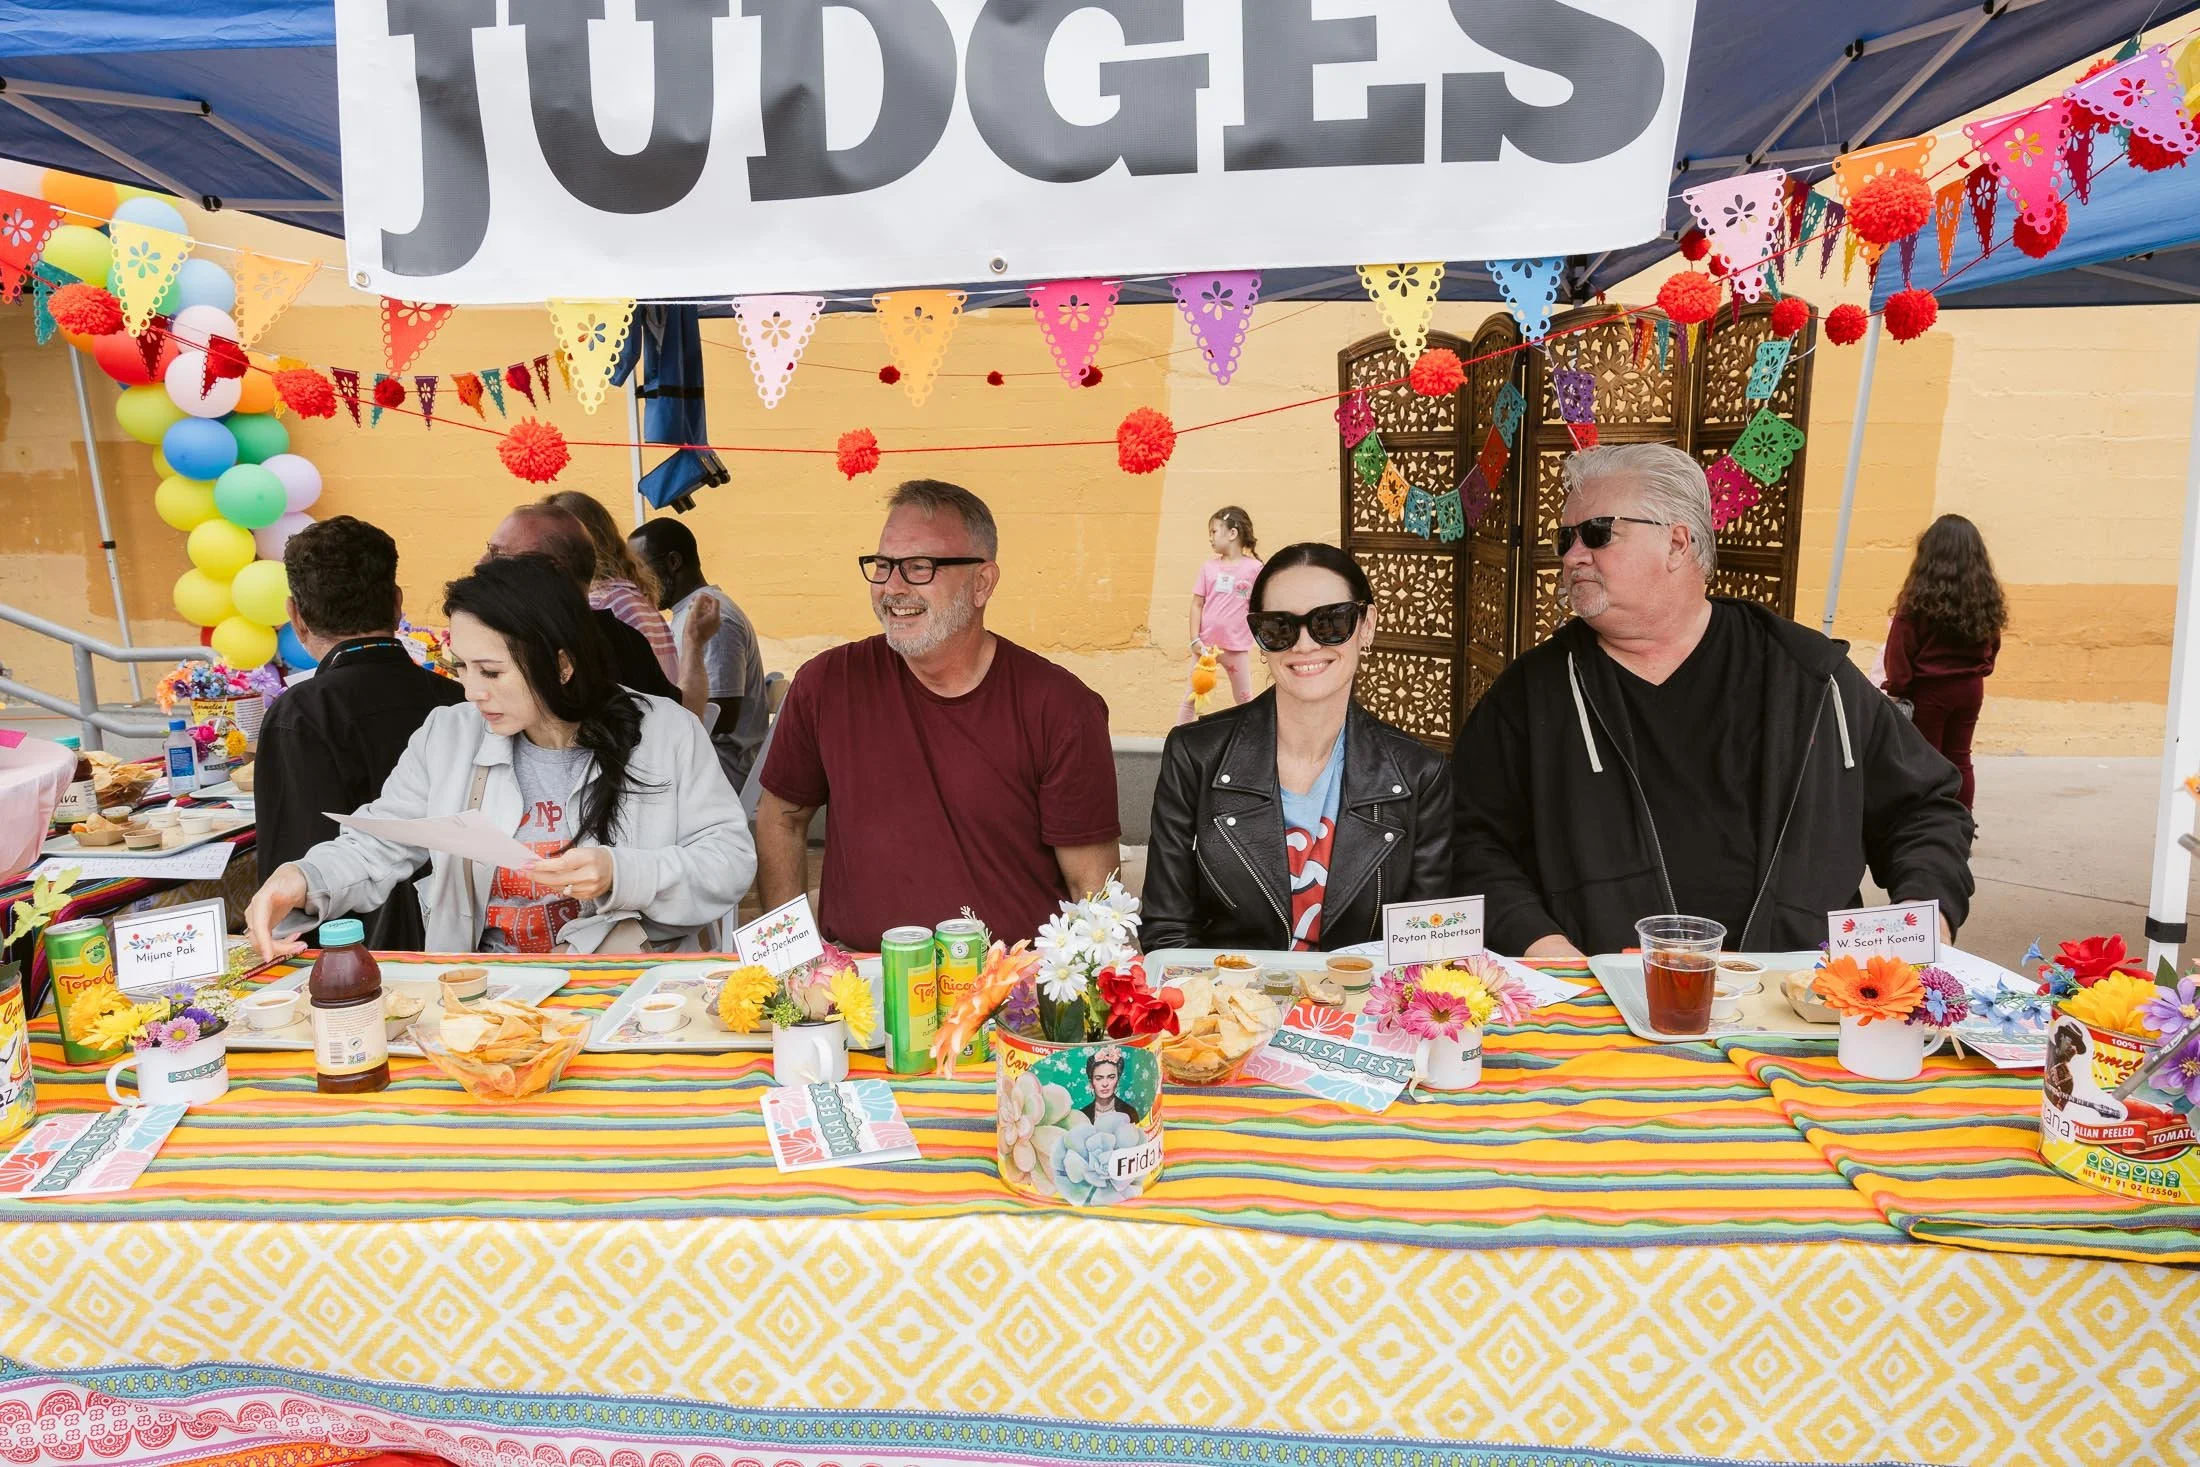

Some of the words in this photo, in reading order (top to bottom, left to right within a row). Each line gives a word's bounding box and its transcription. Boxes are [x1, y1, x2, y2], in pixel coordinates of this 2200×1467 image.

[381, 0, 1667, 276] JUDGES
[535, 800, 563, 832] NP
[752, 944, 771, 962] Chef
[772, 928, 810, 952] Deckman
[1392, 933, 1427, 944] Peyton
[1430, 926, 1481, 940] Robertson
[1836, 938, 1852, 949] W.
[1854, 934, 1884, 948] Scott
[1887, 933, 1925, 946] Koenig
[136, 950, 173, 965] Mijune
[176, 944, 196, 957] Pak
[59, 974, 102, 994] Topo
[1279, 1033, 1345, 1062] SALSA
[1353, 1053, 1408, 1079] FEST
[2111, 1038, 2137, 1051] 100%
[175, 1063, 216, 1081] SALSA
[816, 1087, 840, 1117] FEST
[826, 1118, 854, 1153] SALSA
[2103, 1127, 2135, 1138] PEELED
[43, 1144, 98, 1185] SALSA
[1117, 1152, 1155, 1177] Frida
[2083, 1168, 2096, 1178] NET
[2100, 1174, 2112, 1184] WT
[2116, 1179, 2126, 1189] 91
[2131, 1183, 2142, 1192] OZ
[2146, 1186, 2181, 1199] (2550g)
